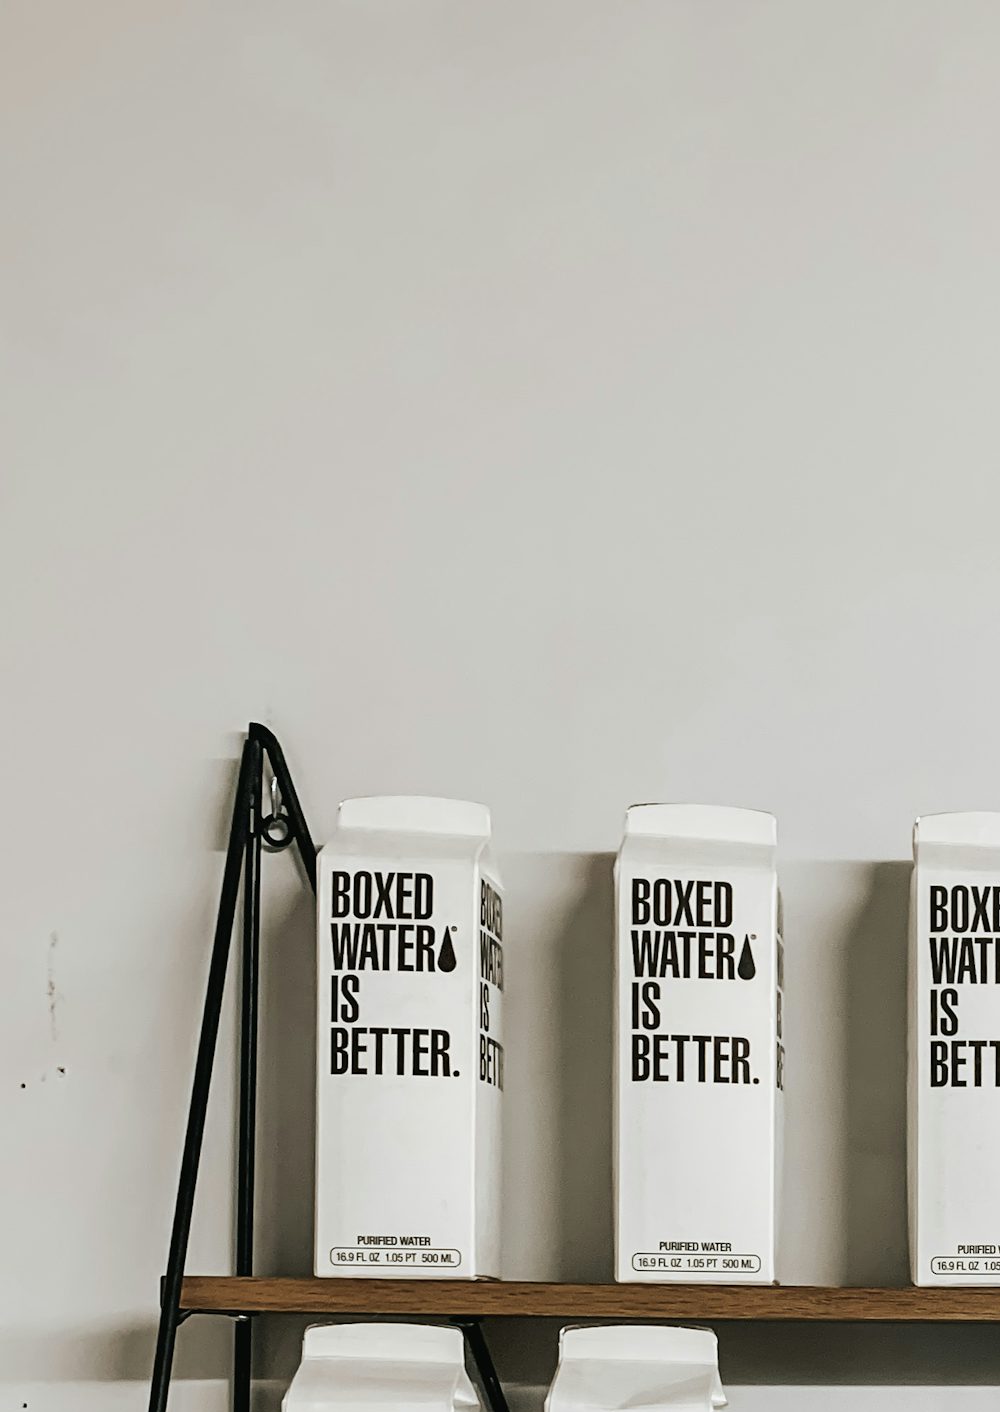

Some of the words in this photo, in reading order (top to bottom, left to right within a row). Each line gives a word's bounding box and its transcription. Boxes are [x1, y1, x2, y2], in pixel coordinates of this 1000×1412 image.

[332, 871, 433, 920] BOXED
[632, 878, 732, 927] BOXED
[331, 923, 435, 972] WATER
[631, 930, 735, 980] WATER
[331, 975, 359, 1023] IS
[480, 982, 490, 1032] IS
[632, 982, 660, 1030] IS
[930, 988, 958, 1036] IS
[331, 1027, 460, 1077] BETTER.
[632, 1034, 759, 1084] BETTER.
[336, 1252, 354, 1262] 16.9
[356, 1252, 367, 1262] FL
[369, 1252, 380, 1262] OZ
[385, 1253, 403, 1263] 1.05
[405, 1253, 417, 1262] PT
[421, 1254, 439, 1263] 500
[440, 1254, 455, 1264] ML
[357, 1235, 398, 1246] PURIFIED
[399, 1236, 431, 1246] WATER
[638, 1258, 656, 1267] 16.9
[658, 1258, 669, 1267] FL
[670, 1258, 682, 1267] OZ
[687, 1259, 705, 1268] 1.05
[706, 1259, 718, 1268] PT
[722, 1259, 739, 1269] 500
[741, 1259, 755, 1269] ML
[659, 1241, 699, 1251] PURIFIED
[701, 1242, 732, 1252] WATER
[957, 1245, 996, 1254] PURIFIED
[937, 1261, 955, 1271] 16.9
[956, 1261, 967, 1271] FL
[968, 1261, 980, 1271] OZ
[984, 1262, 1000, 1271] 1.05
